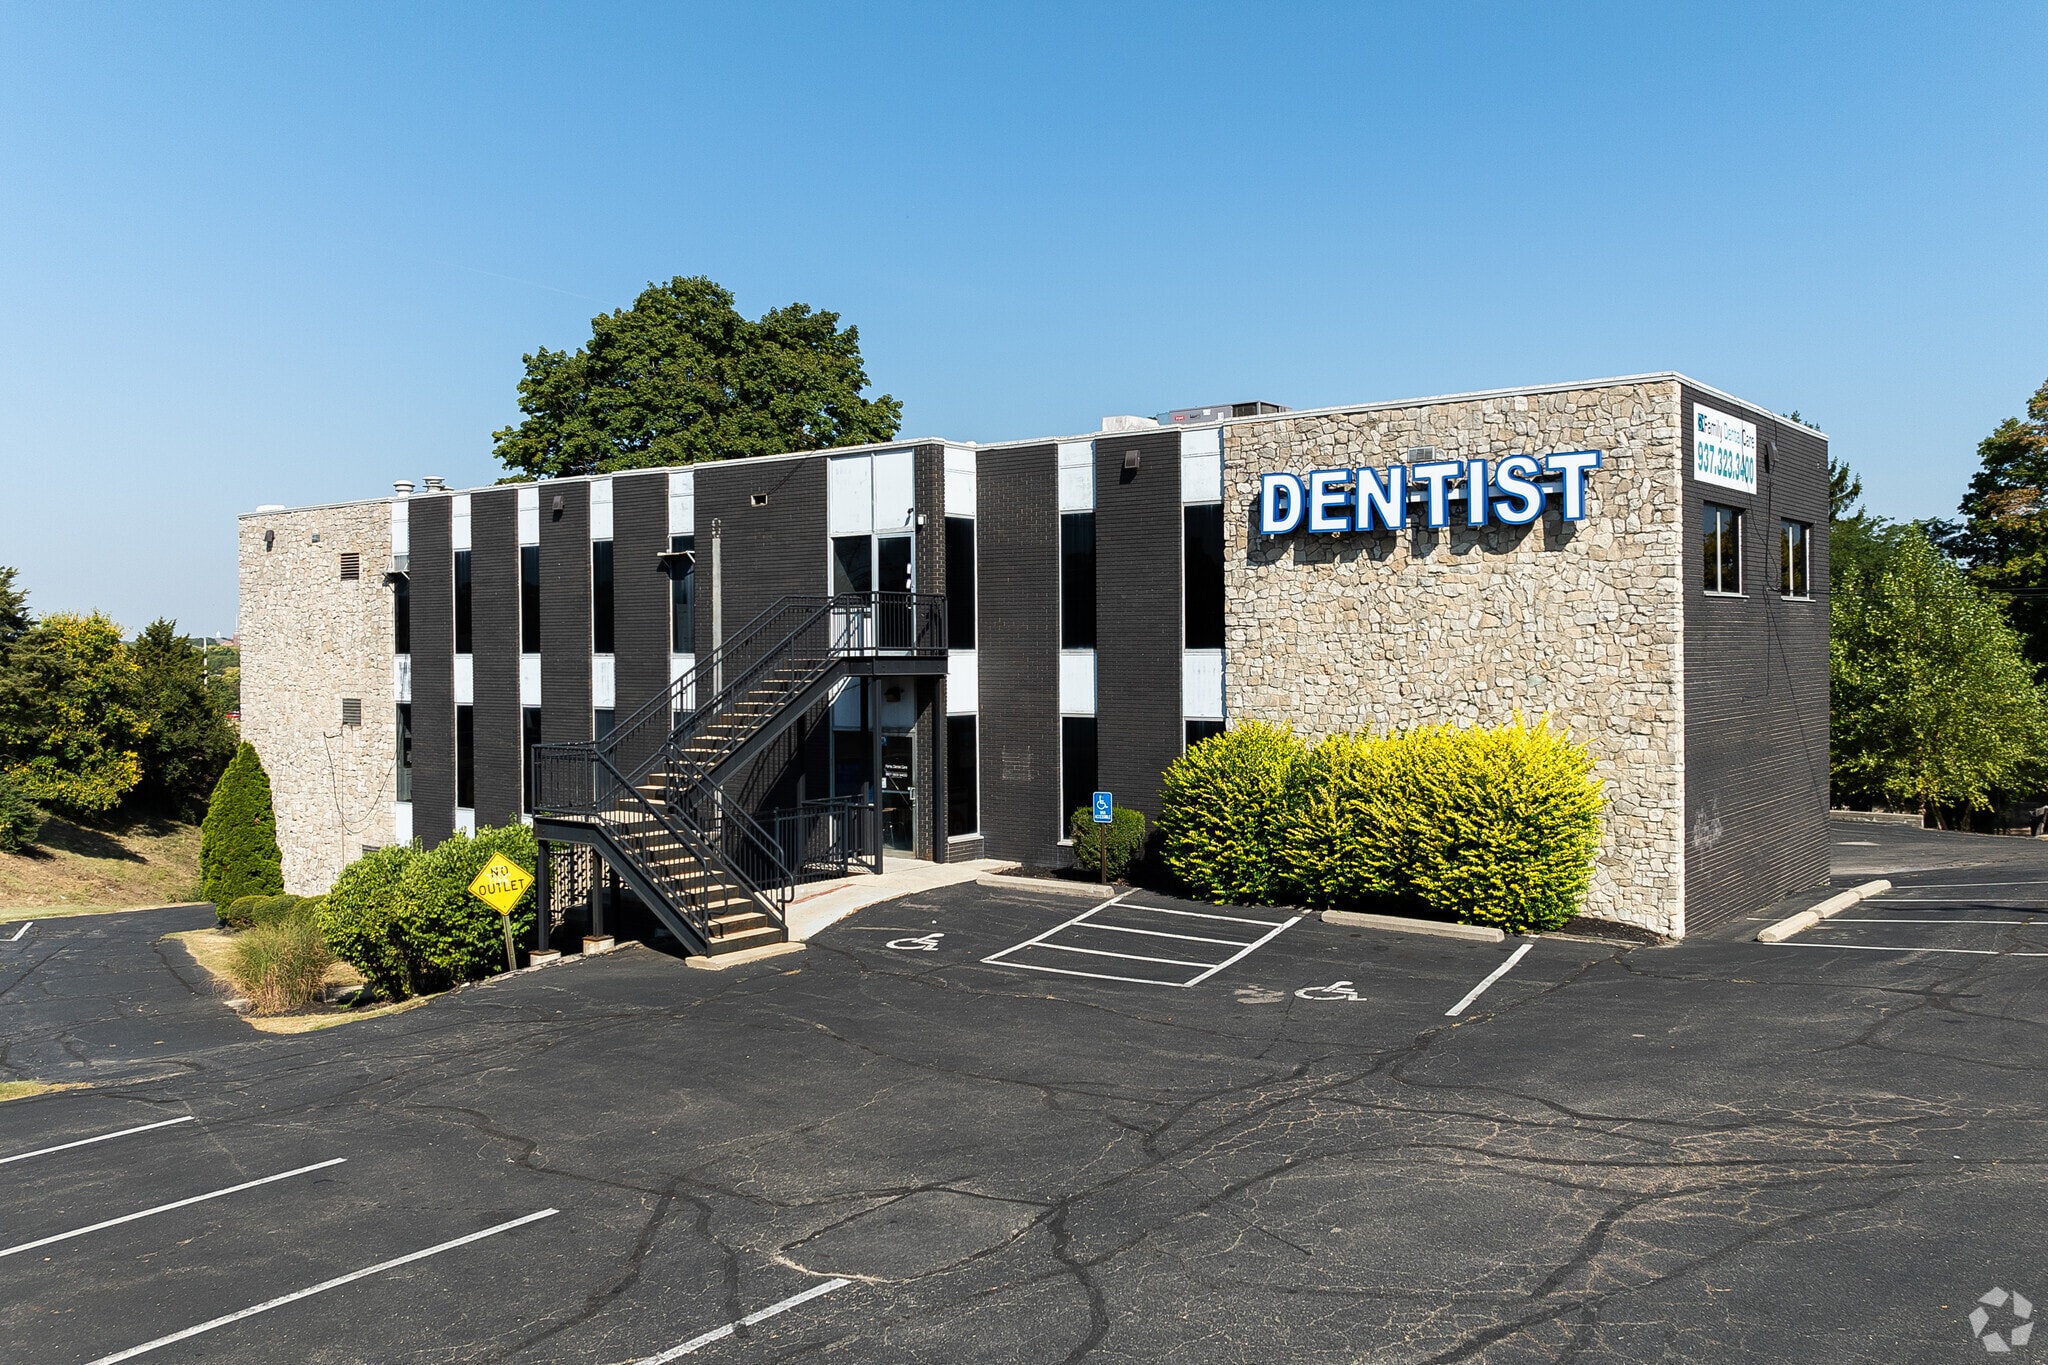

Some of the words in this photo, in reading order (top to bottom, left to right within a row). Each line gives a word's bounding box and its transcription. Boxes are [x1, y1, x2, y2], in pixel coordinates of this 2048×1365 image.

[1697, 441, 1754, 485] 937.323.3400
[1260, 450, 1602, 535] DENTIST
[490, 866, 509, 877] NO
[478, 879, 524, 896] OUTLET
